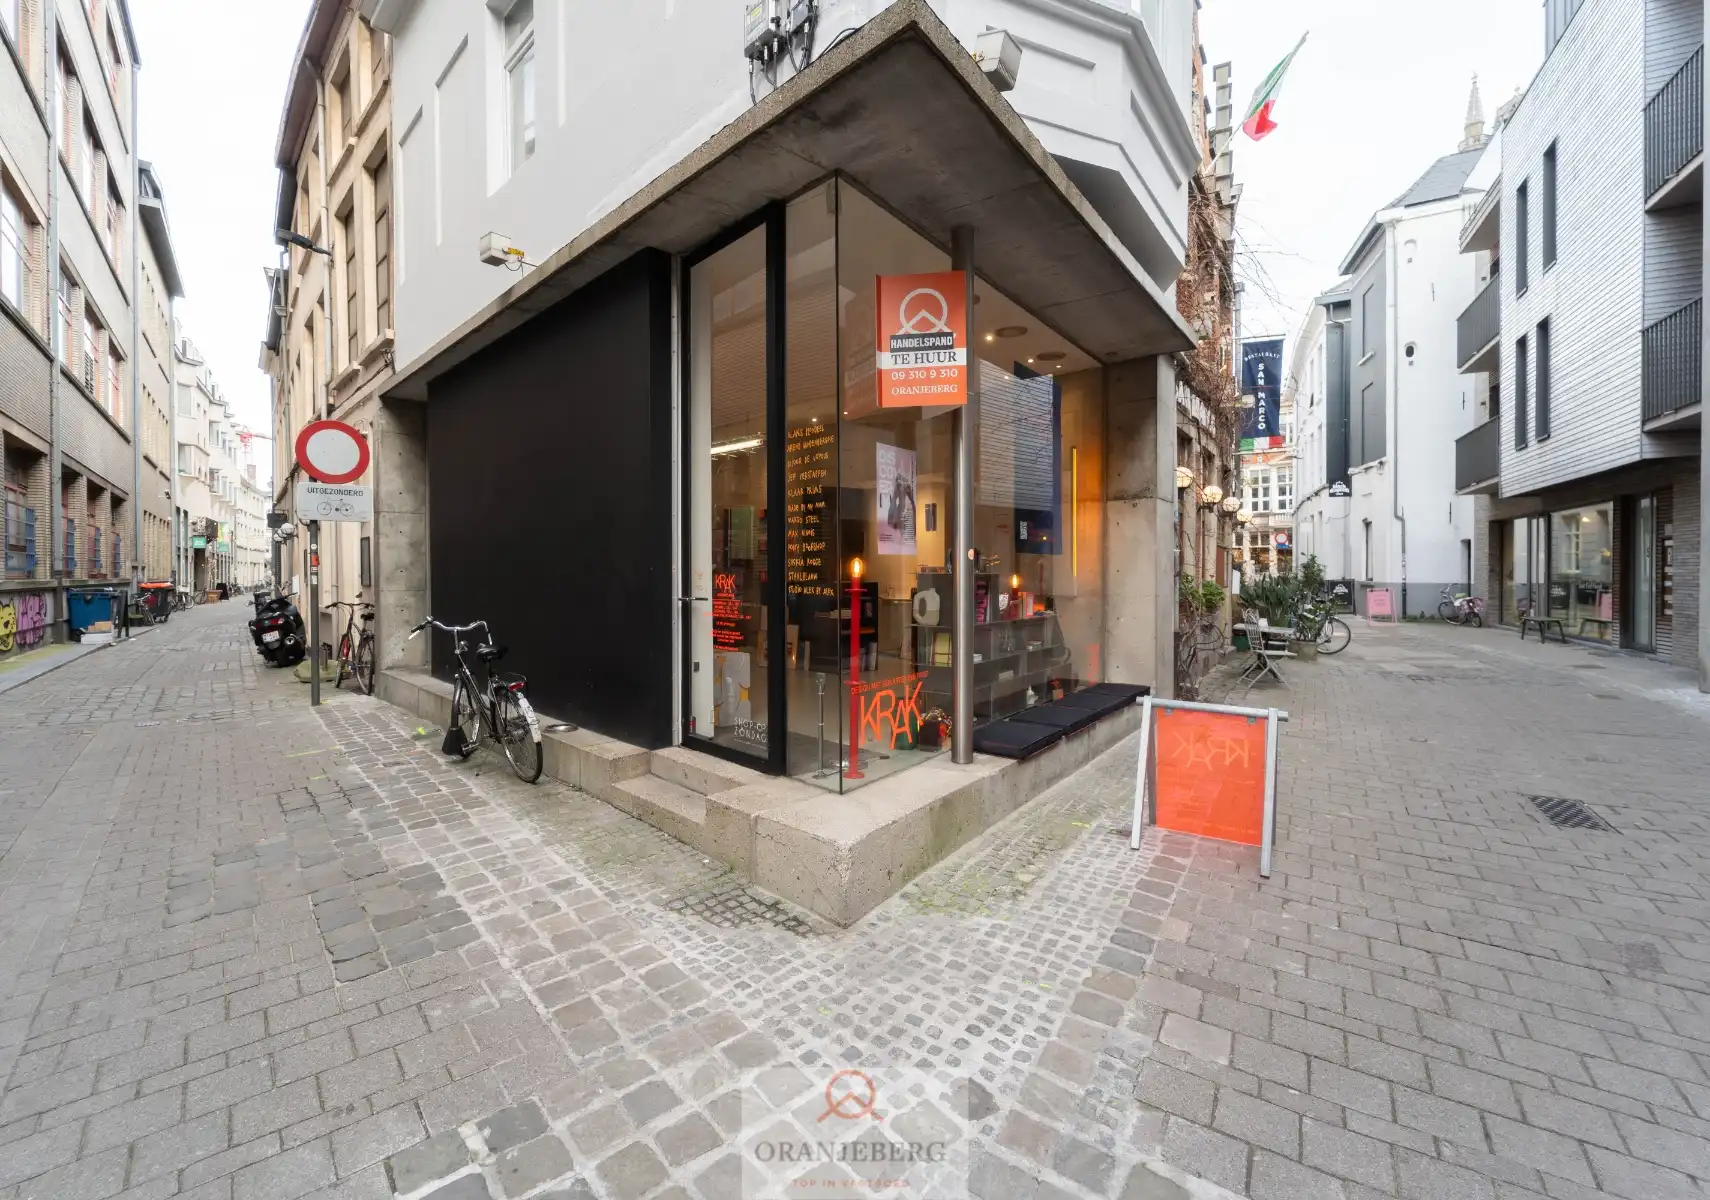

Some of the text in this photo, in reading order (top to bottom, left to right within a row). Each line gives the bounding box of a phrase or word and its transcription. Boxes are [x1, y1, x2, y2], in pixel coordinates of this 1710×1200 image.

[890, 336, 953, 349] HANDELSPAND
[891, 351, 957, 365] TE HUUR
[891, 368, 958, 380] 09 310 9 310
[891, 384, 958, 396] ORANJEBERG
[1257, 363, 1266, 430] SAN MARCO
[307, 486, 364, 497] UITGEZONDERD
[715, 574, 735, 593] KRAK
[860, 681, 924, 751] KRAK
